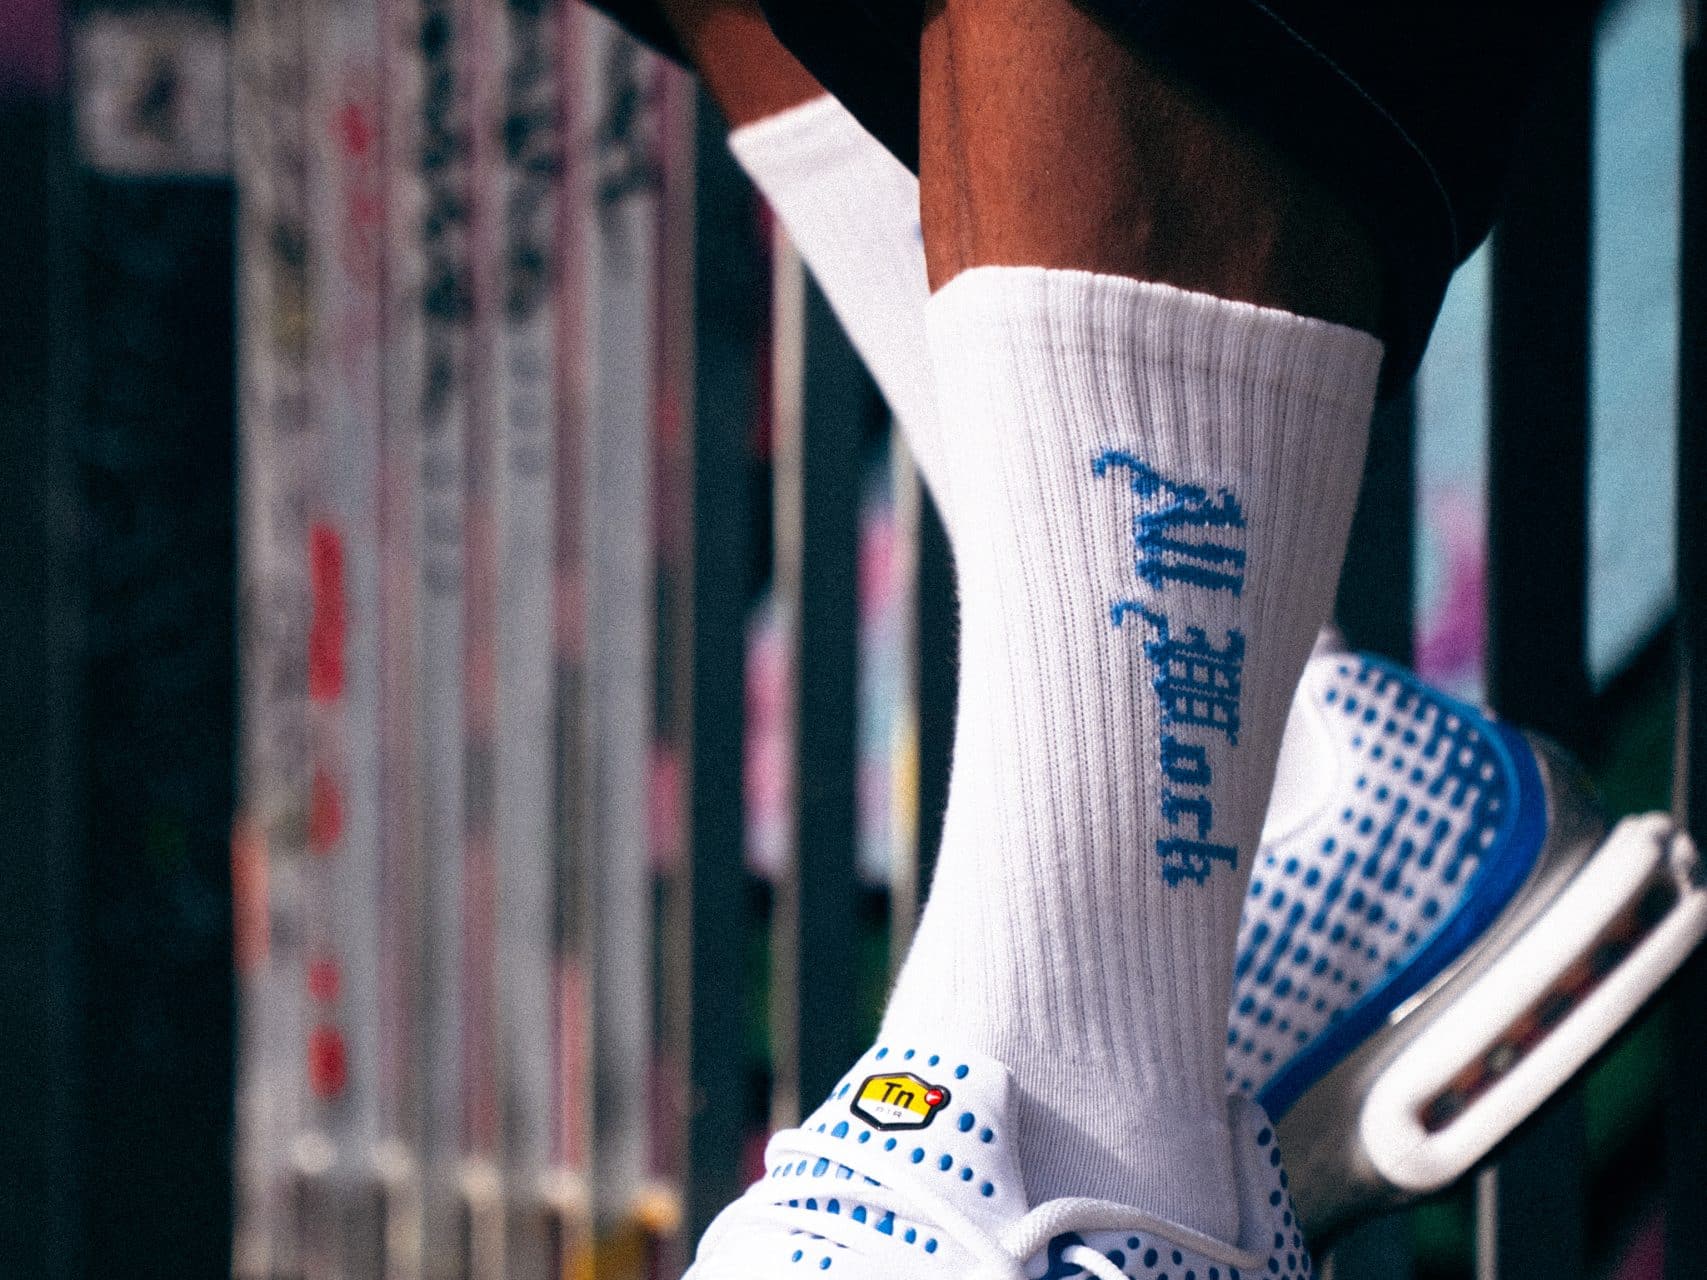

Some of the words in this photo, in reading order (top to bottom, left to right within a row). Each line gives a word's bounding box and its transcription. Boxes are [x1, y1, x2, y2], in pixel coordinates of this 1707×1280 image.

[1092, 449, 1247, 598] All
[1111, 601, 1247, 888] Work
[882, 1081, 915, 1109] Tn
